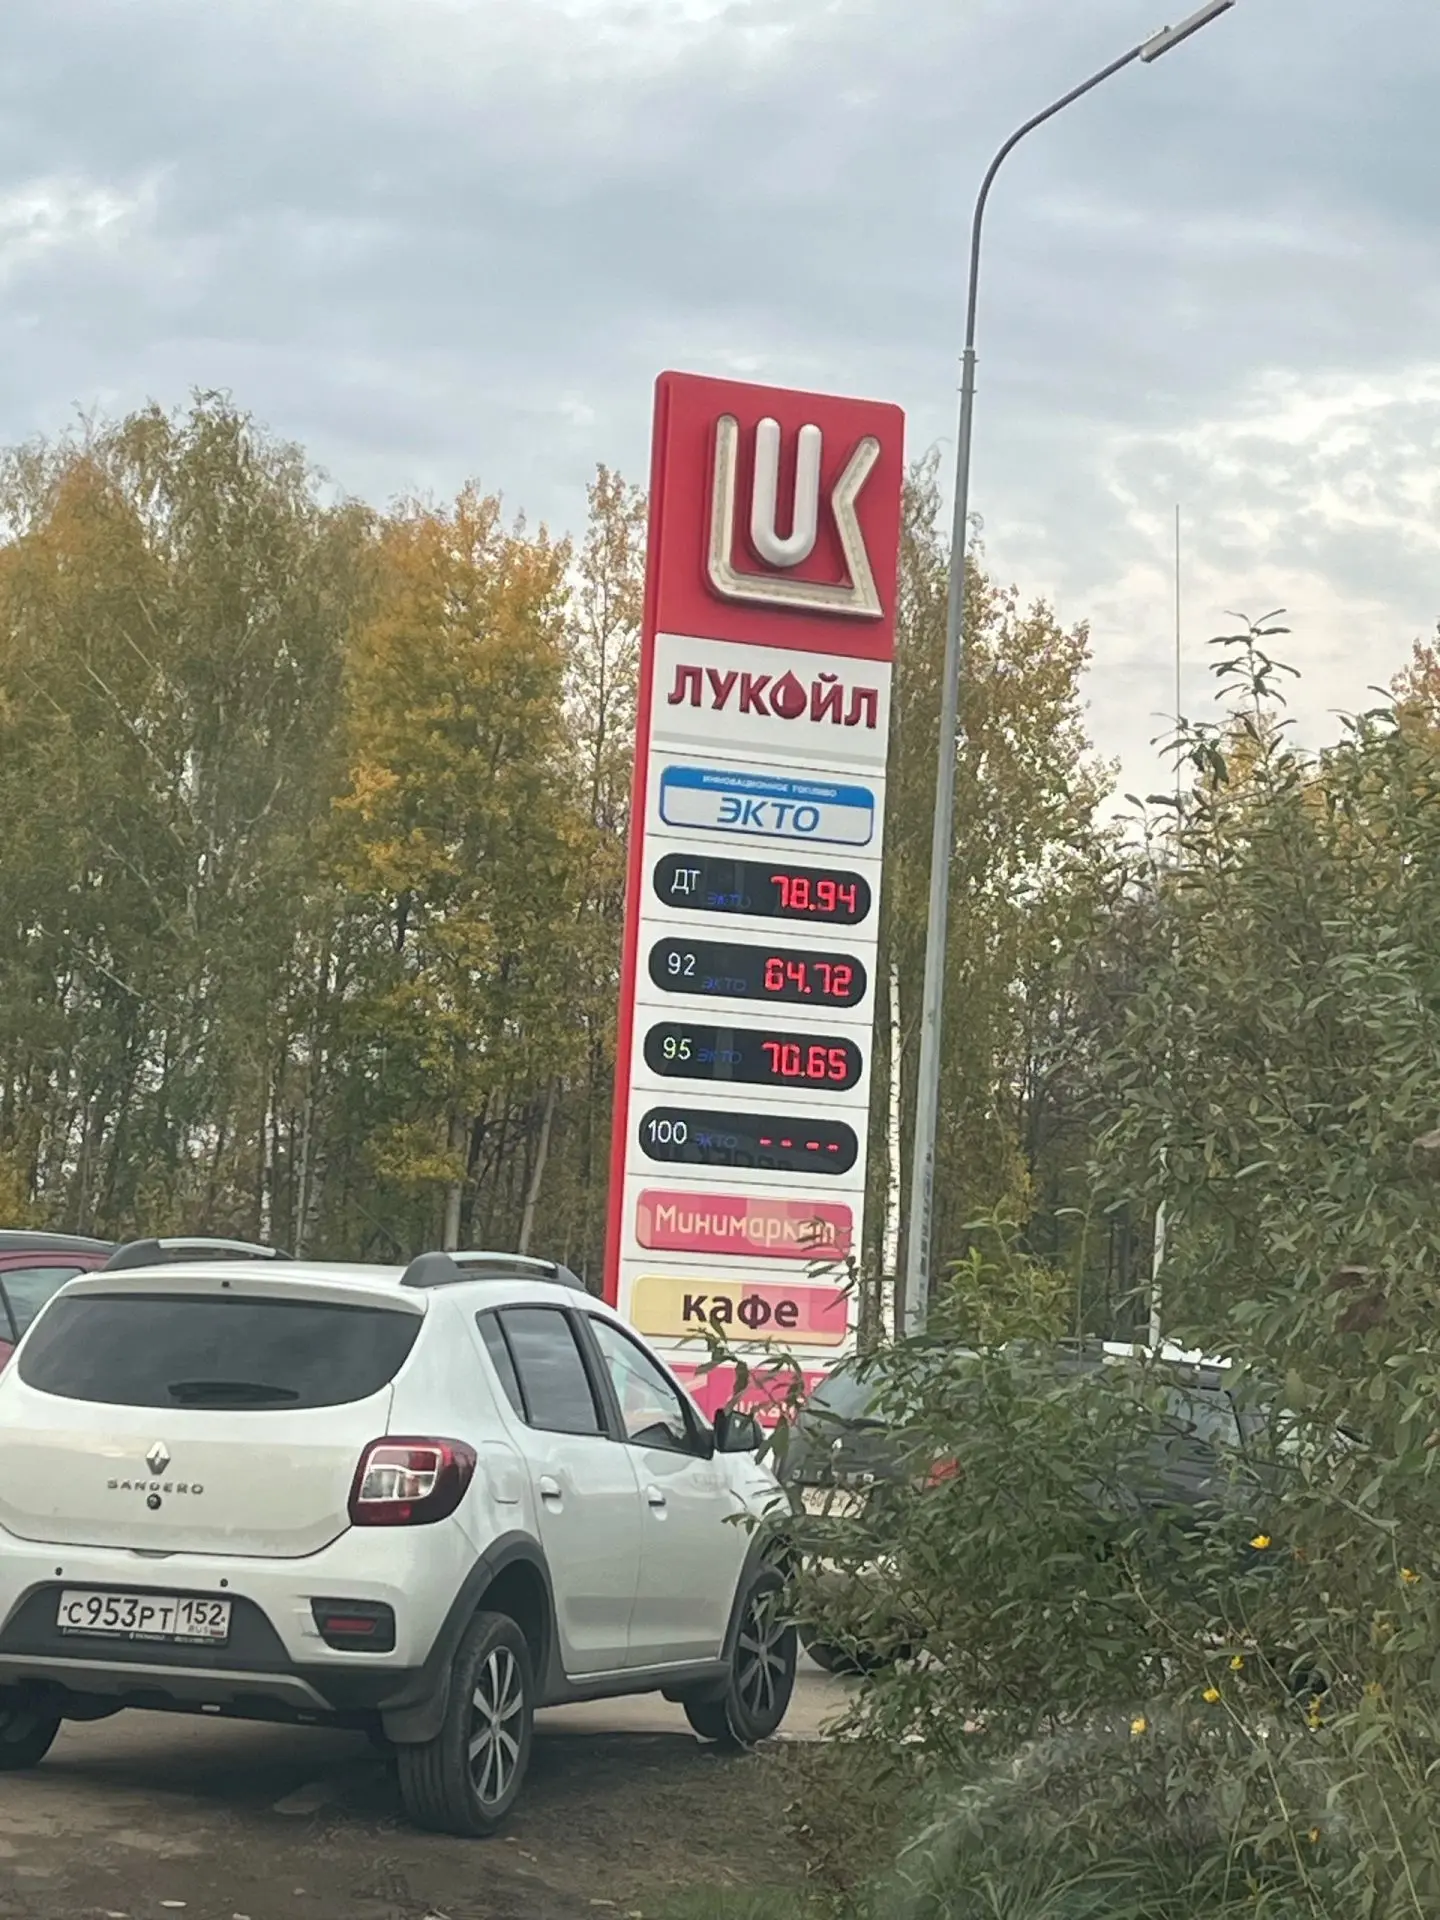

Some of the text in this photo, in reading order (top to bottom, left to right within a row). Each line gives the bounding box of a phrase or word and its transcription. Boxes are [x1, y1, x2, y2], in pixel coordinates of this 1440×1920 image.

[668, 664, 879, 729] ЛУКОЙЛ
[717, 797, 820, 833] ЭКТО
[671, 868, 702, 895] ДТ
[771, 875, 857, 913] 78.94
[667, 952, 697, 976] 92
[764, 958, 853, 997] 64.72
[662, 1036, 692, 1061] 95
[762, 1041, 848, 1081] 70.65
[648, 1119, 688, 1144] 100
[682, 1293, 800, 1330] кафе
[107, 1478, 204, 1494] SANDERO
[181, 1601, 223, 1626] 152
